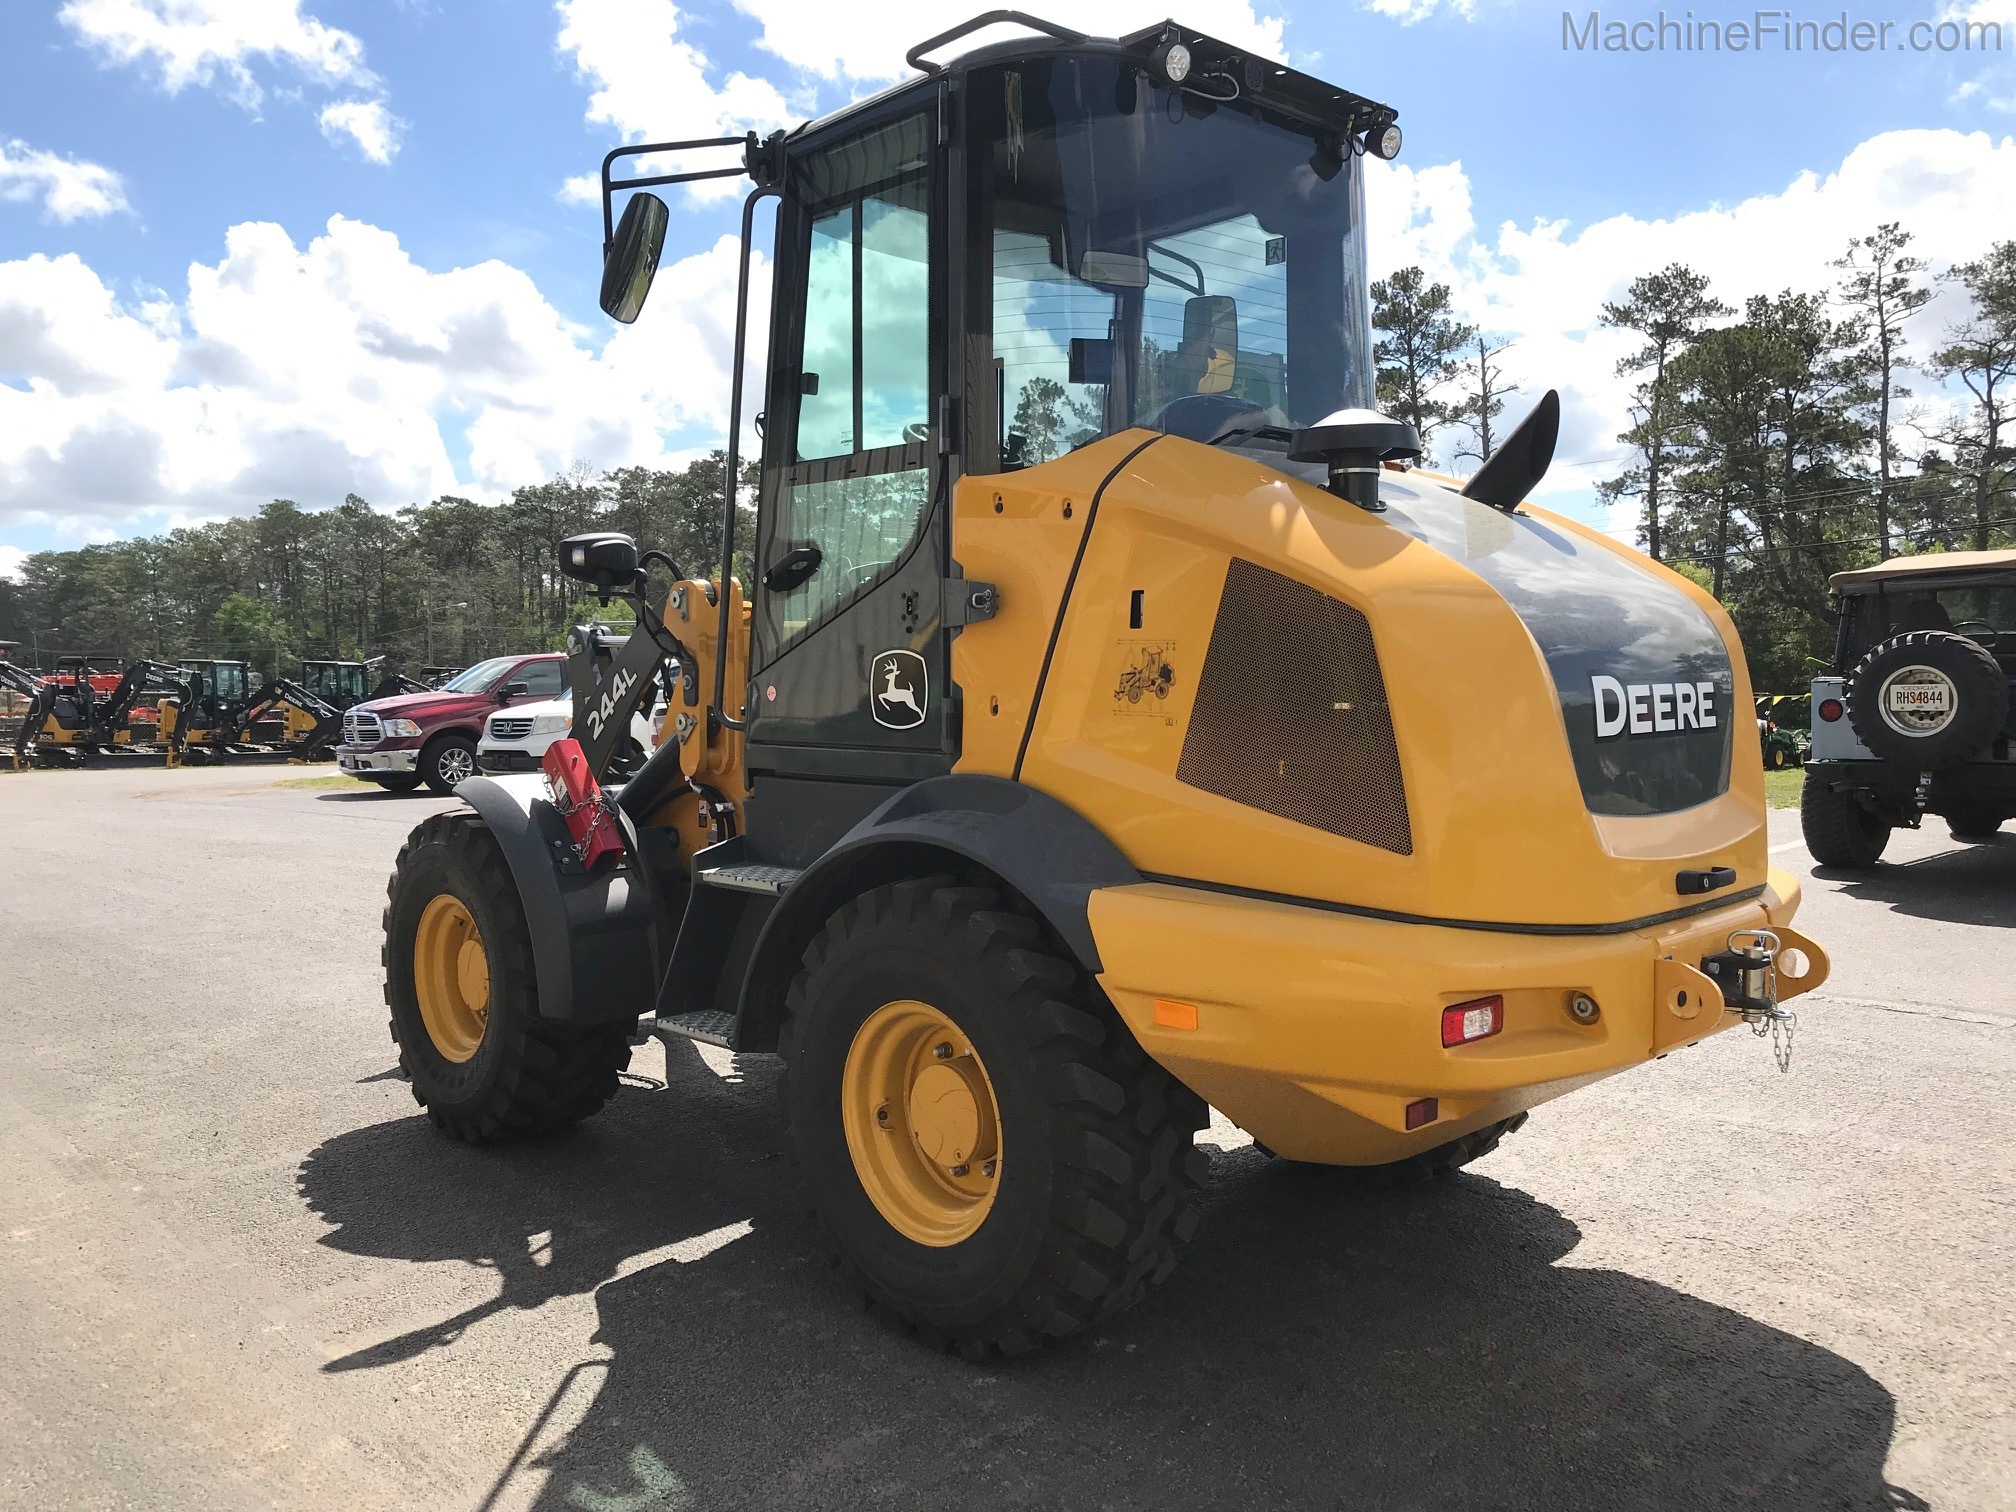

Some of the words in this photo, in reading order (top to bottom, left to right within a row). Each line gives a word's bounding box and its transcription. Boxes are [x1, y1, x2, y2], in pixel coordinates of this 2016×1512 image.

[586, 667, 638, 741] 244L
[1591, 675, 1717, 738] DEERE
[1896, 691, 1943, 705] RHS4844
